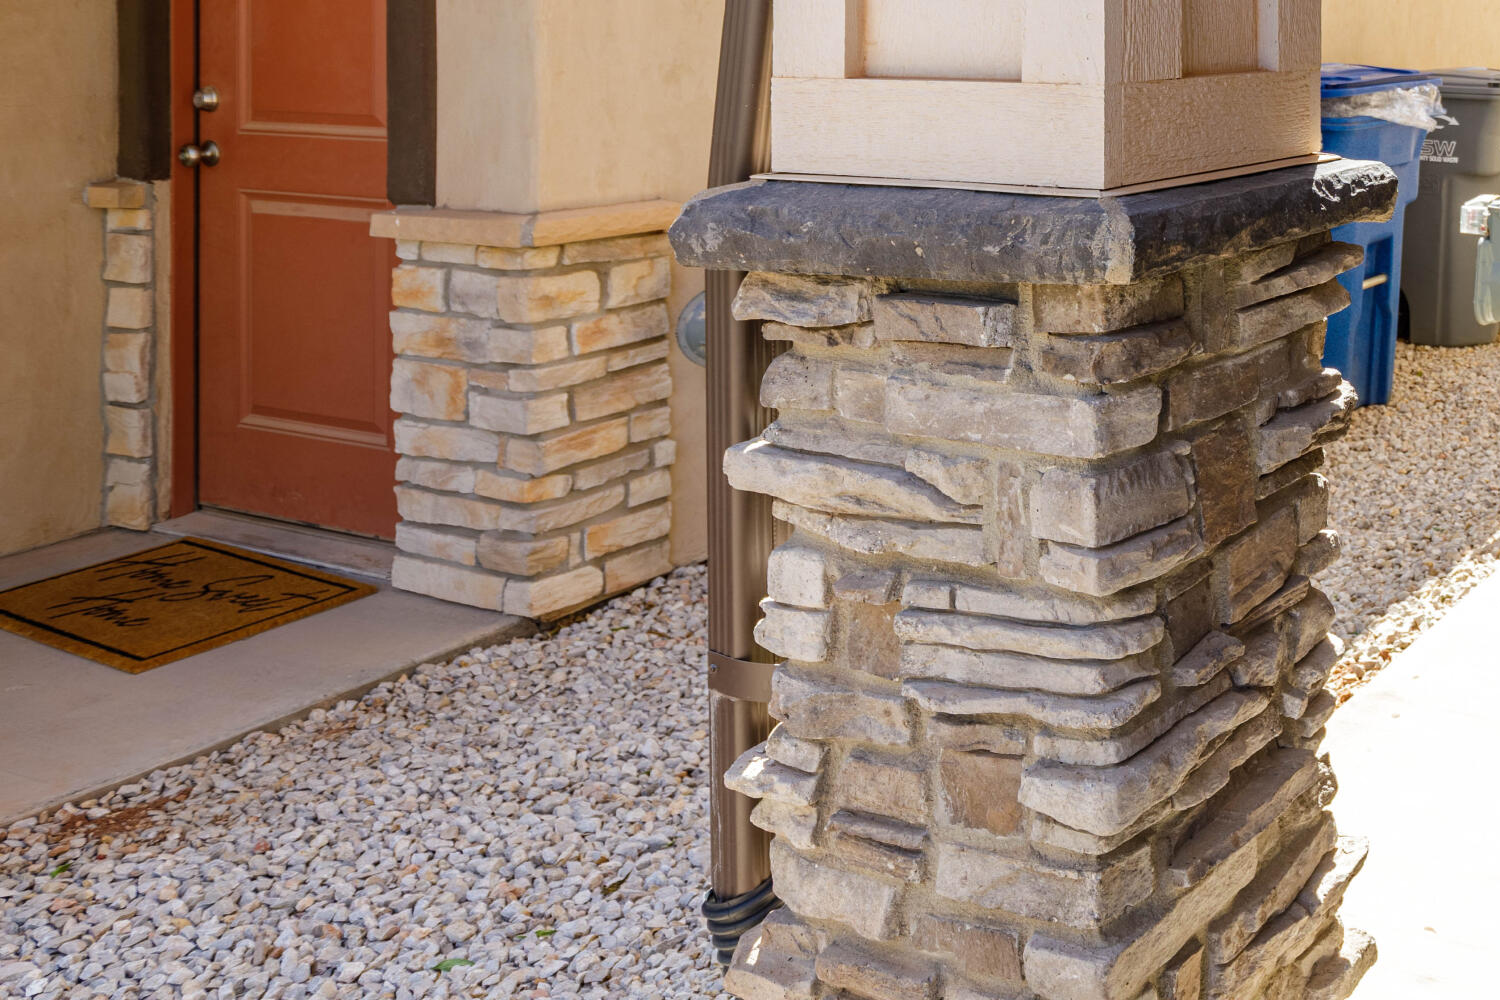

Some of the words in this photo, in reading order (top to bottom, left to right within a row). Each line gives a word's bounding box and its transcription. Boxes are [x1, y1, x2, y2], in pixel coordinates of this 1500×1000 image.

[46, 587, 150, 627] Home
[95, 551, 208, 589] Home
[159, 574, 330, 614] Sweet
